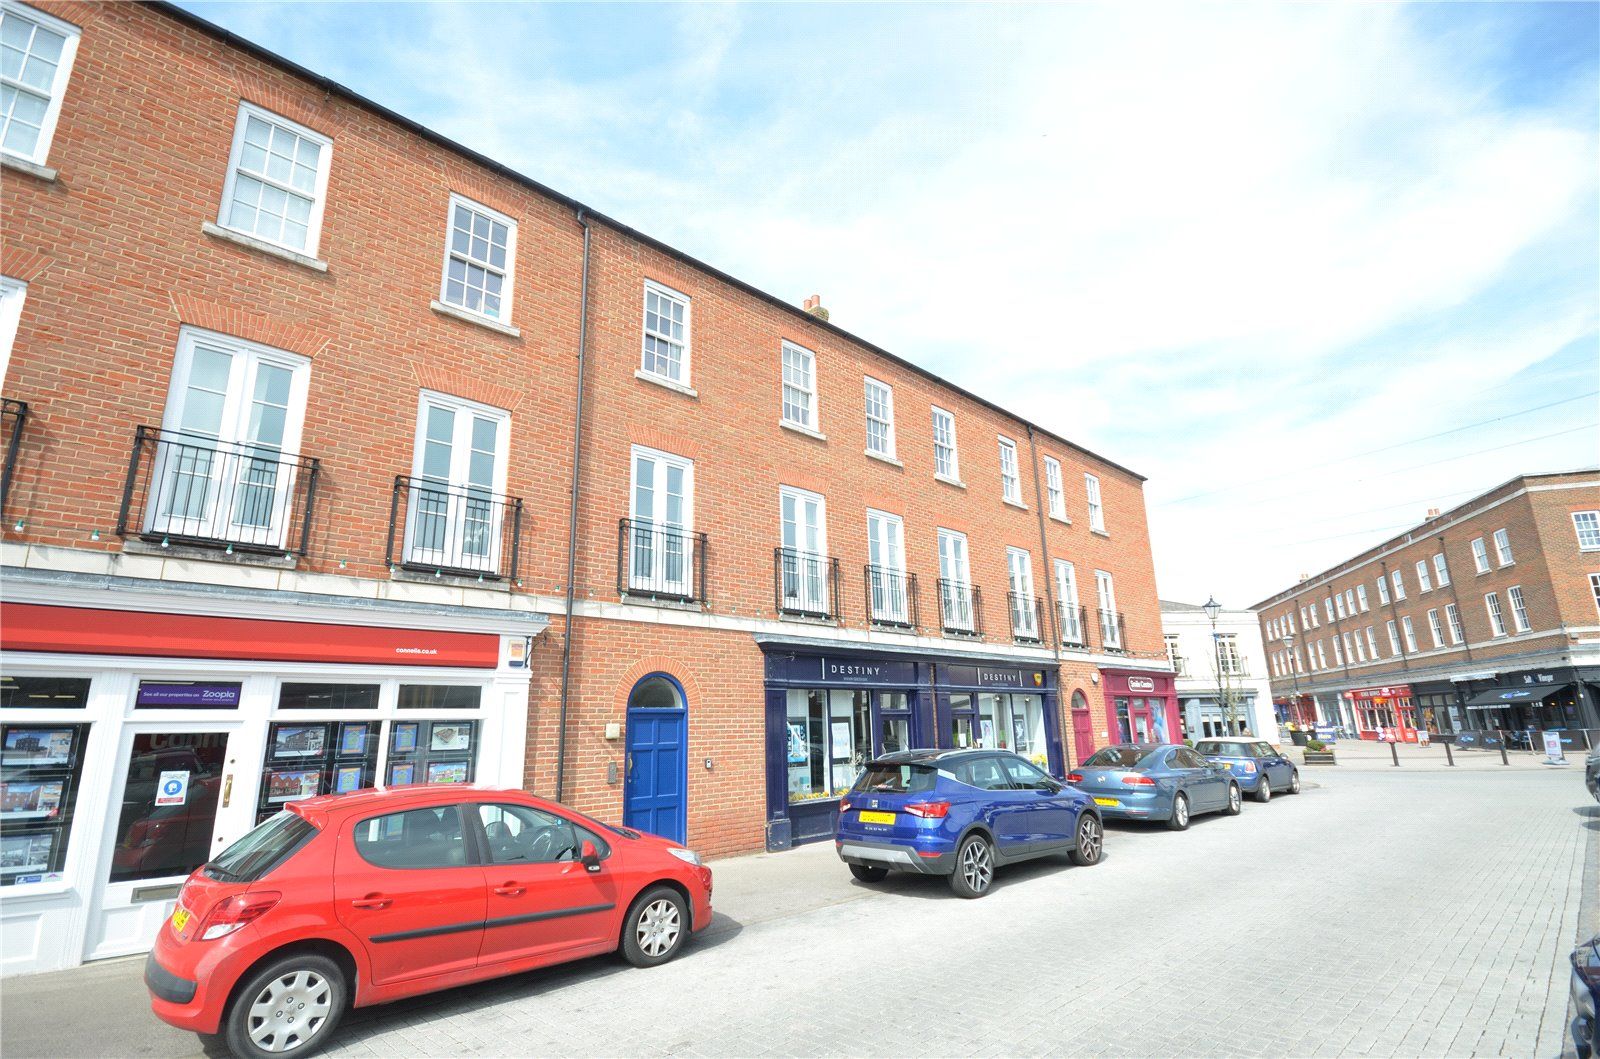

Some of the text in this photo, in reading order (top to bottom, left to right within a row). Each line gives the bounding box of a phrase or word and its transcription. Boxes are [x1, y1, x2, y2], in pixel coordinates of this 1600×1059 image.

[831, 664, 880, 676] DESTINY
[983, 673, 1016, 682] DESTINY
[202, 690, 235, 699] Zoopla
